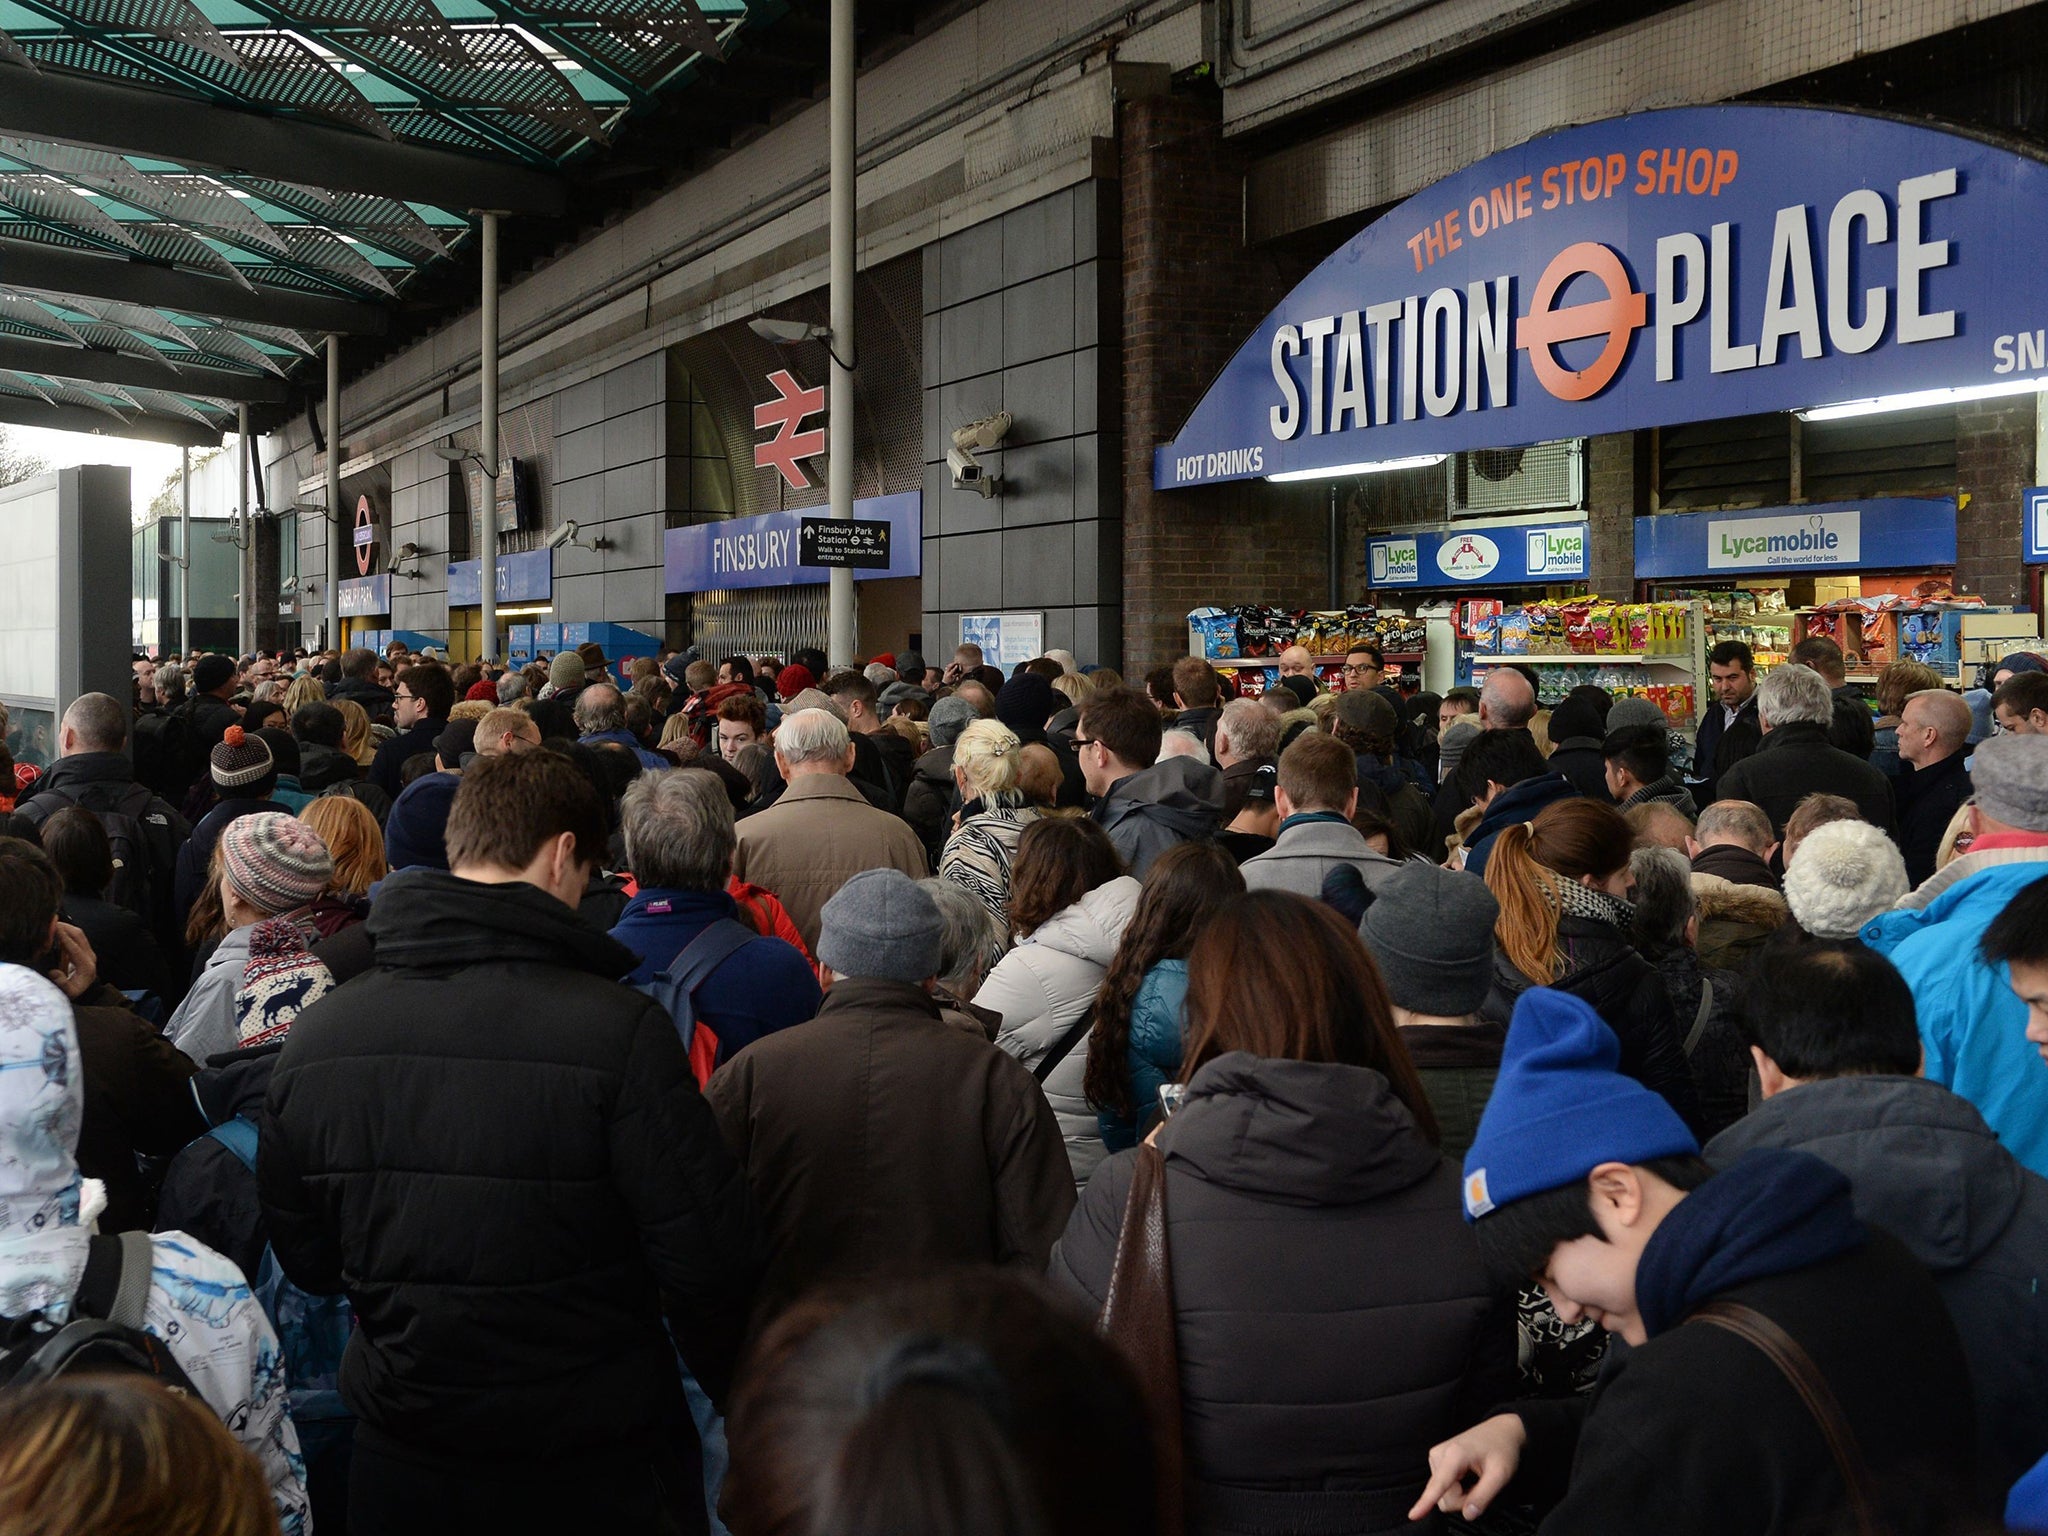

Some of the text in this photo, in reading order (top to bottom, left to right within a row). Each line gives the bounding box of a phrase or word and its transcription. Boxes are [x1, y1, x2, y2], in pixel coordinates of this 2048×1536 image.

[1407, 148, 1739, 273] THE ONE STOP SHOP
[1270, 167, 1957, 441] STATION PLACE
[1993, 330, 2048, 375] SN
[1176, 446, 1264, 482] HOT DRINKS
[818, 525, 873, 536] Finsbury Park
[818, 535, 848, 544] Station
[714, 529, 790, 573] FINSBURY
[1548, 535, 1582, 555] Lyca
[1721, 528, 1838, 558] Lycamobile
[1388, 547, 1415, 565] Lyca
[1548, 552, 1582, 565] mobile
[1767, 556, 1780, 564] Call
[1794, 554, 1813, 563] world
[1813, 553, 1824, 562] for
[1824, 553, 1838, 562] less
[1389, 563, 1416, 574] mobile
